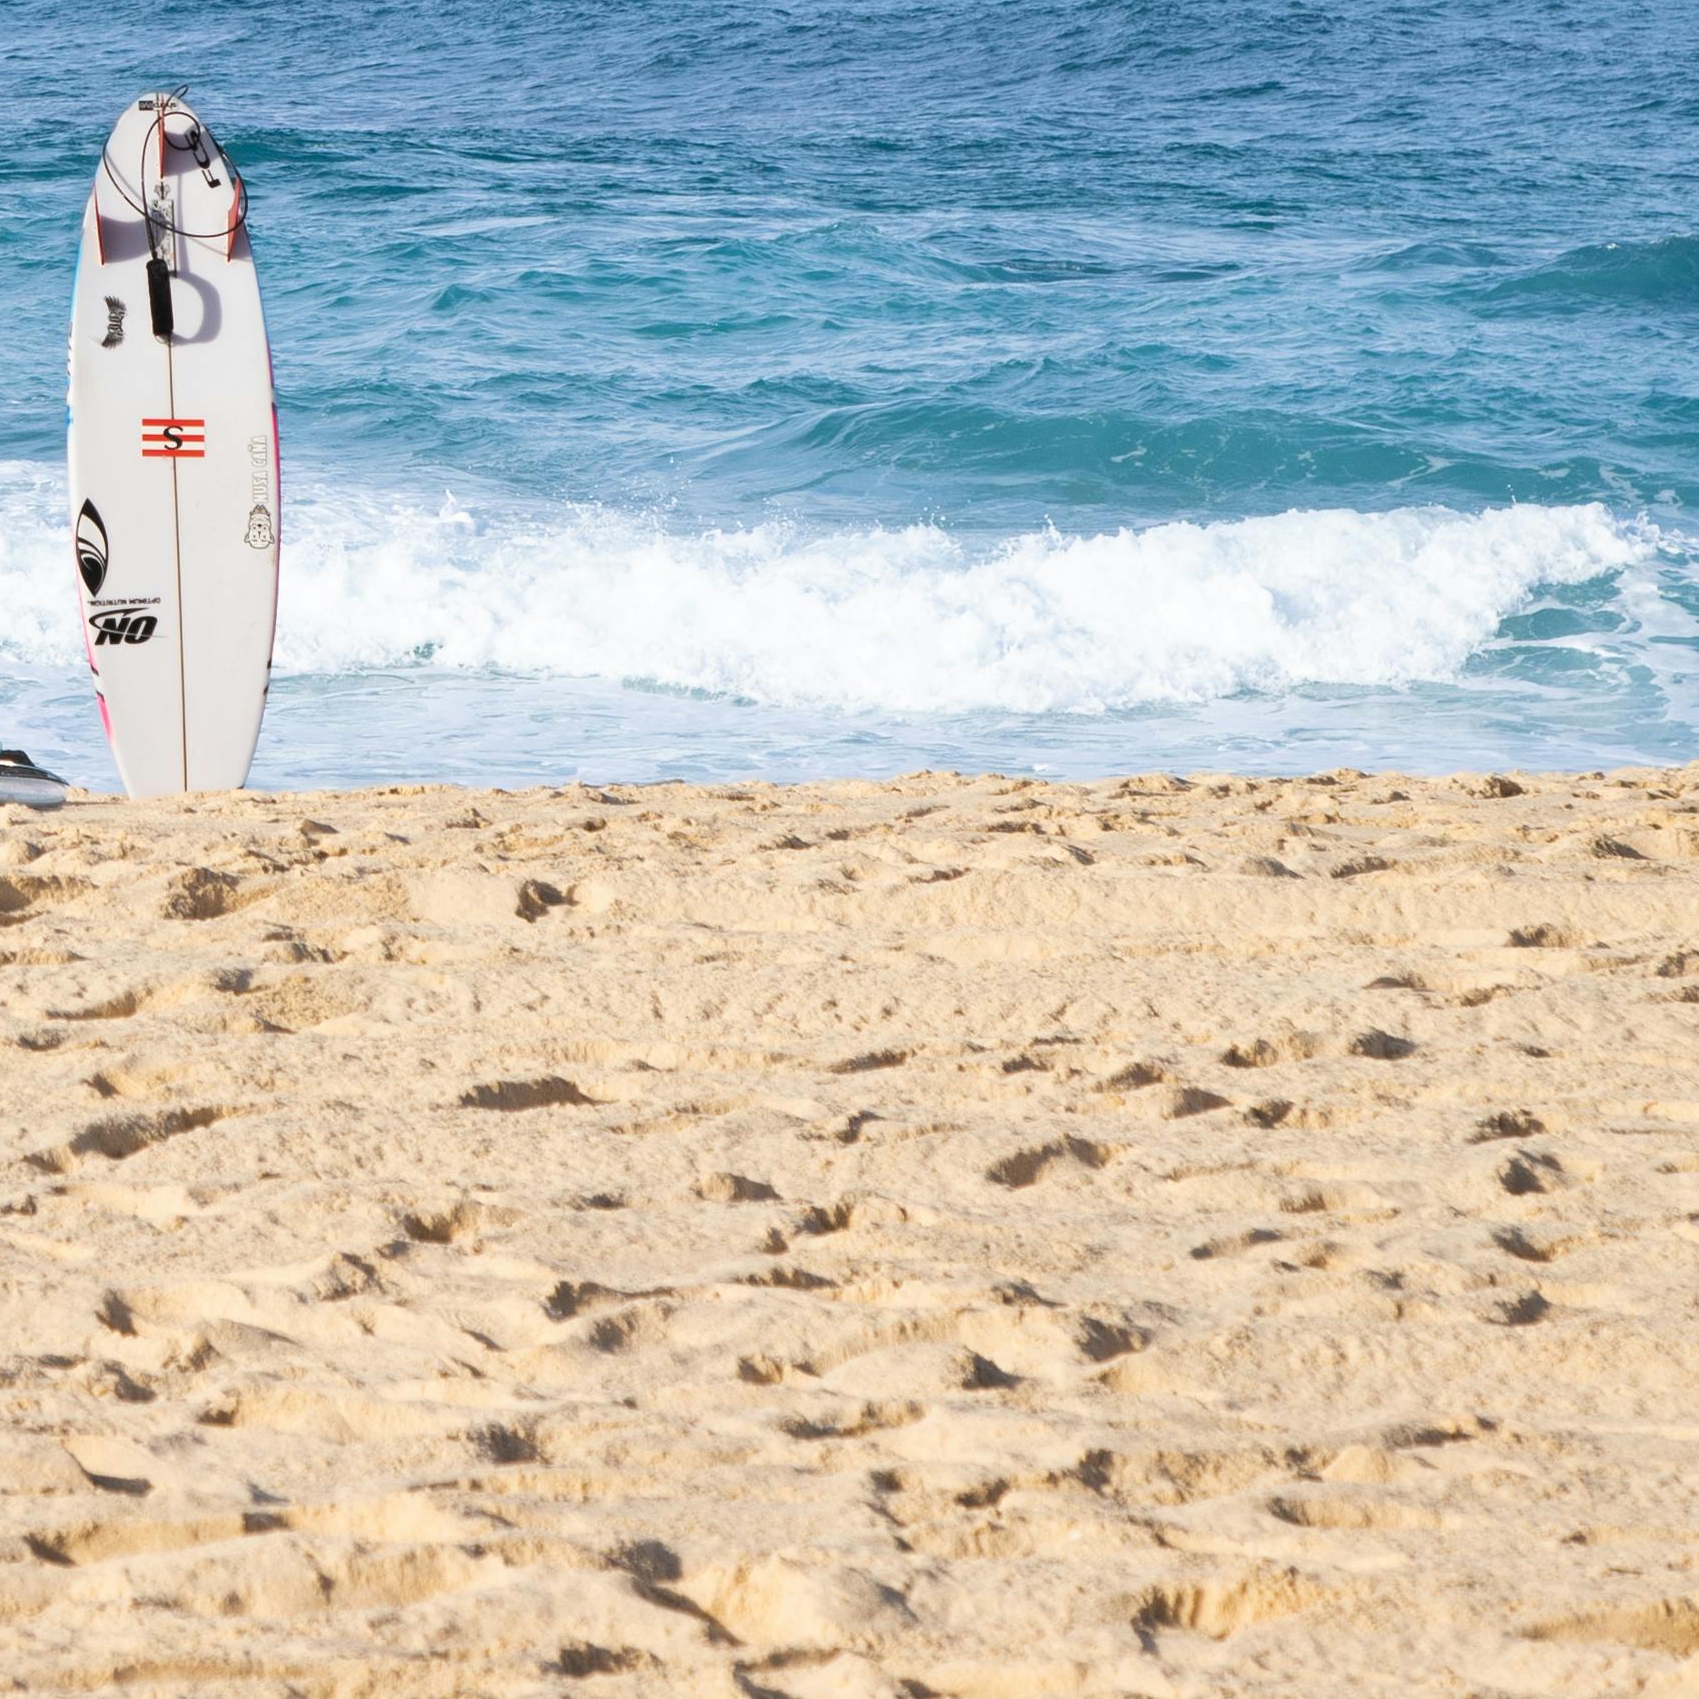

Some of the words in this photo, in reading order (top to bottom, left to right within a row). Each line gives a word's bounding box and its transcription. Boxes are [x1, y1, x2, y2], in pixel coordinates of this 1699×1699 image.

[163, 426, 183, 450] S
[90, 599, 127, 607] NUTRITION
[128, 597, 161, 605] OPTIMUM
[94, 616, 158, 646] ON
